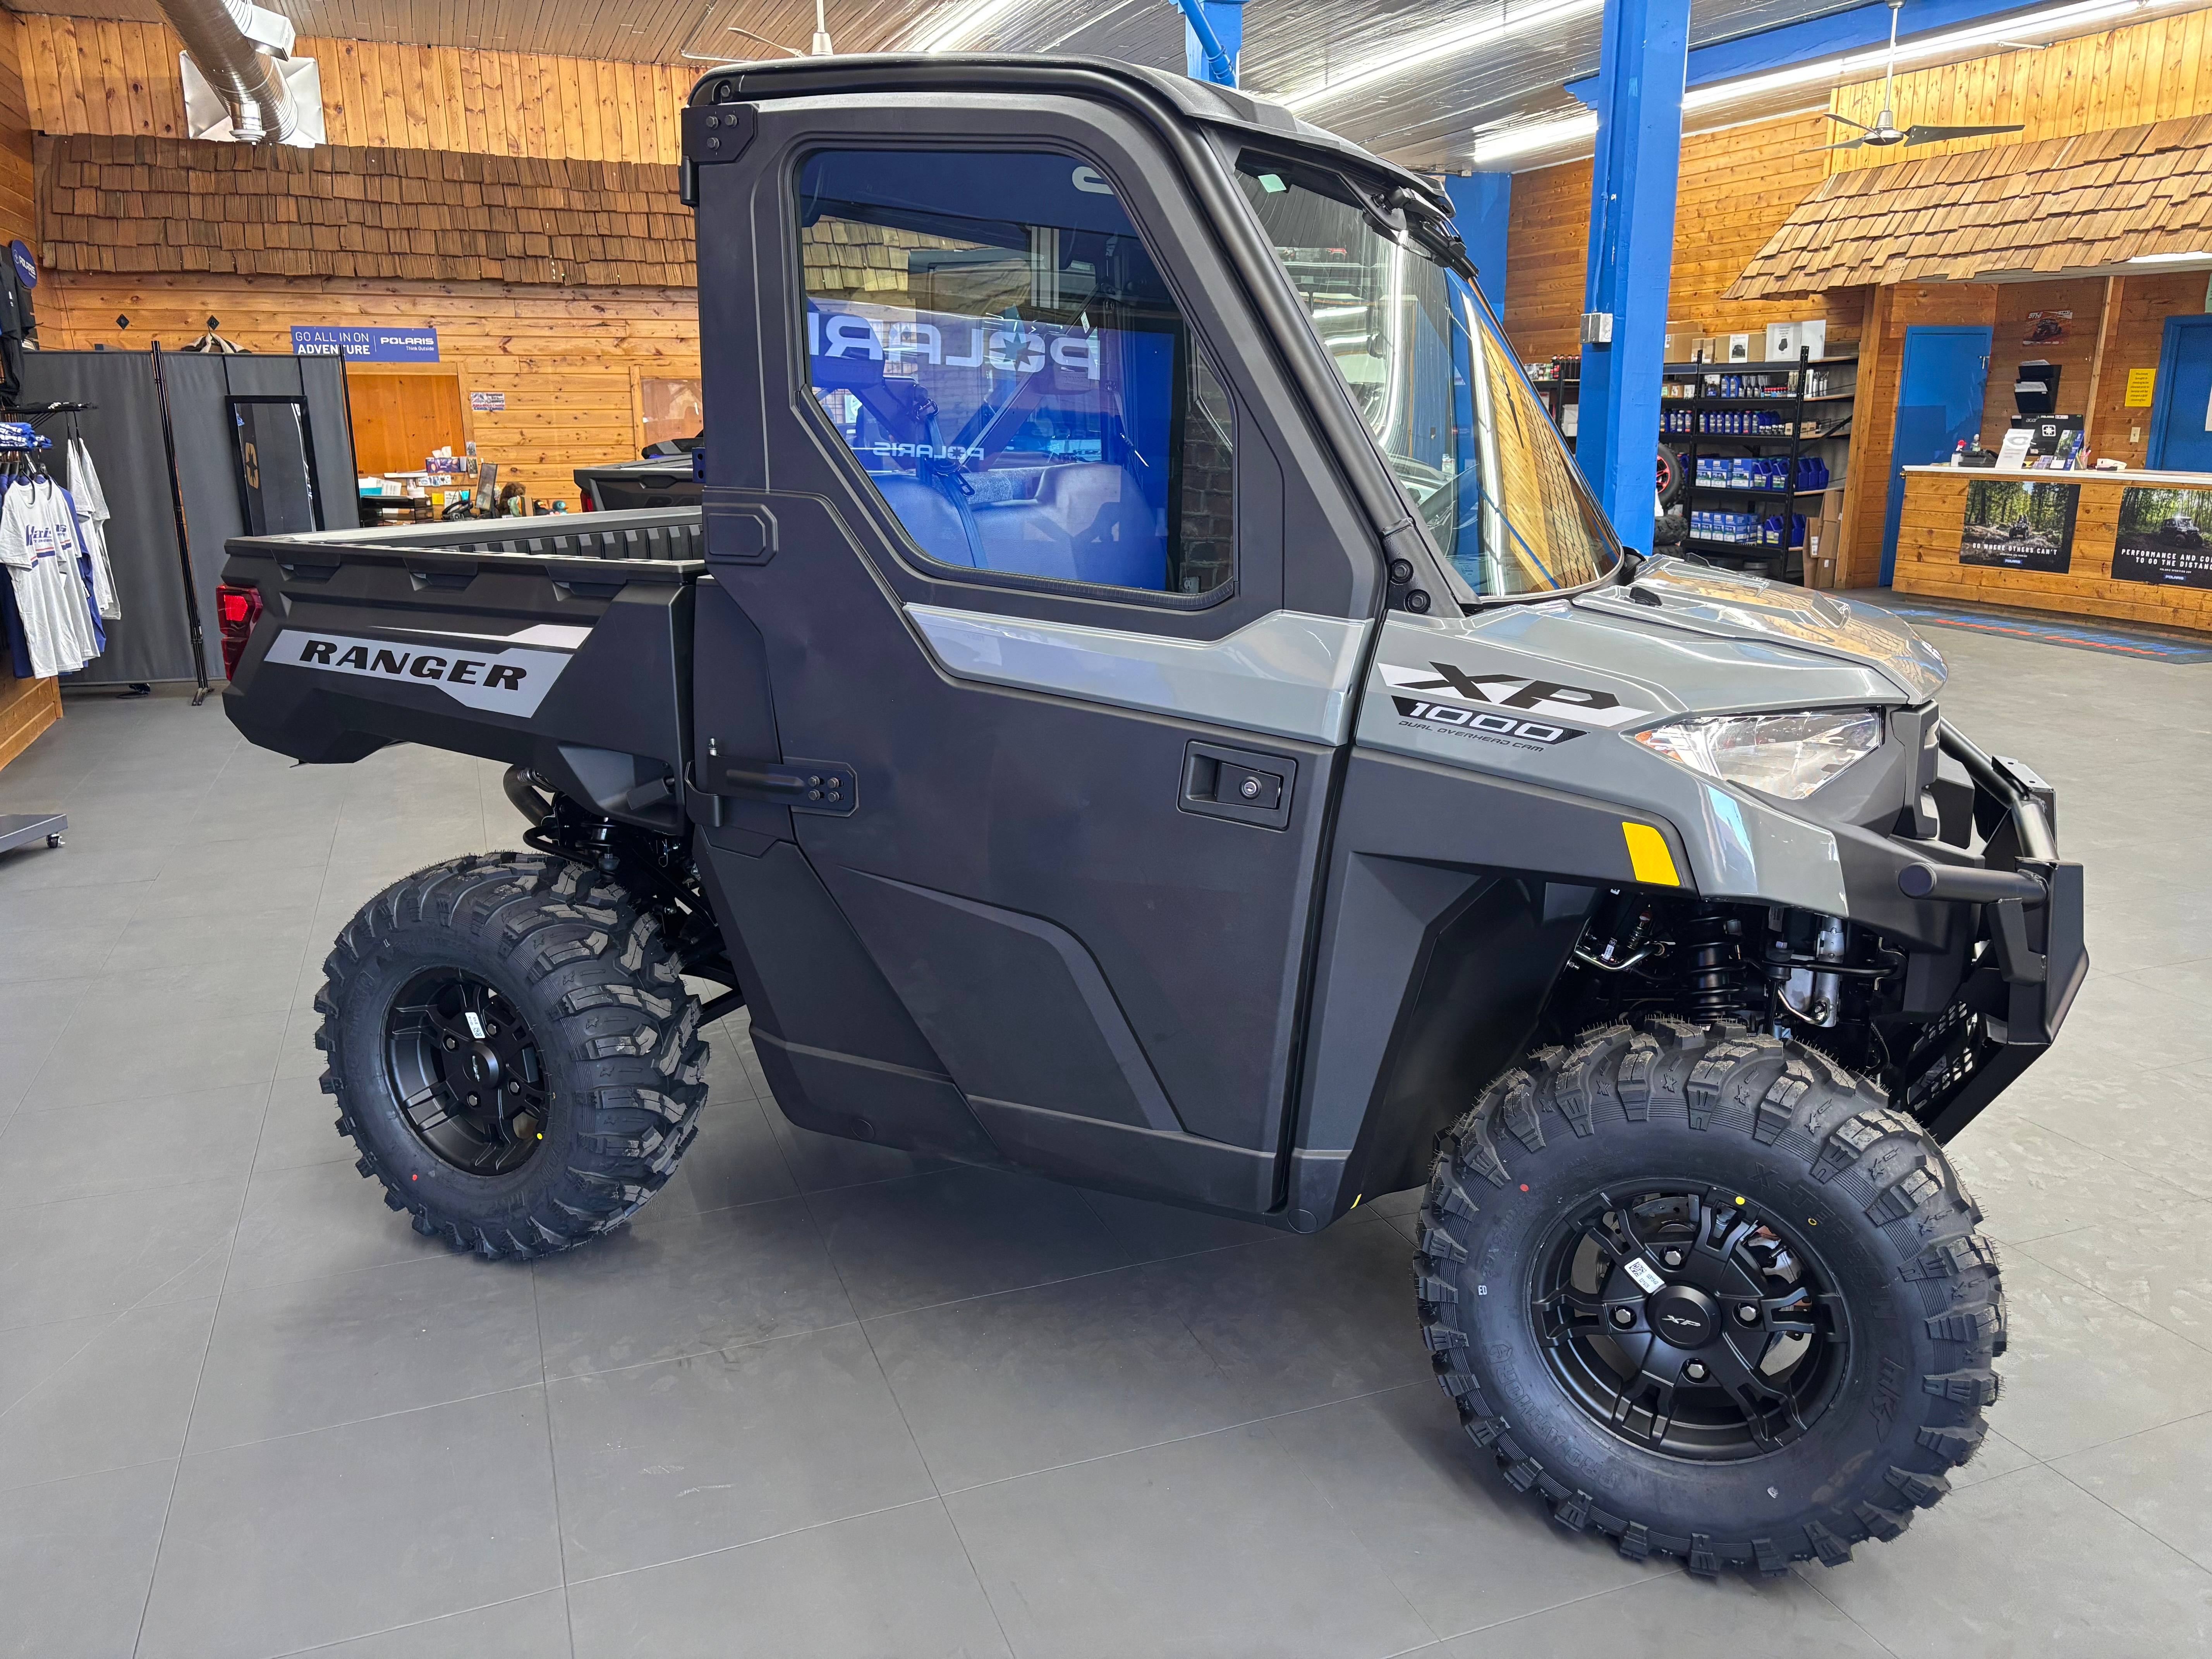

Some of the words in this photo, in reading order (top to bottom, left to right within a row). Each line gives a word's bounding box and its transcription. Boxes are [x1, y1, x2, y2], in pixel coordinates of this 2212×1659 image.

[295, 332, 311, 342] GO
[315, 332, 337, 342] ALL
[340, 332, 350, 342] IN
[354, 333, 369, 342] ON
[2121, 548, 2177, 560] PERFORMANCE
[299, 640, 527, 691] RANGER
[1392, 661, 1621, 709] XP
[1398, 720, 1434, 731] DUAL
[1437, 728, 1511, 745] OVERHEAD
[1512, 742, 1545, 752] CAM
[1409, 702, 1563, 742] 1000
[1662, 1315, 1701, 1327] XP
